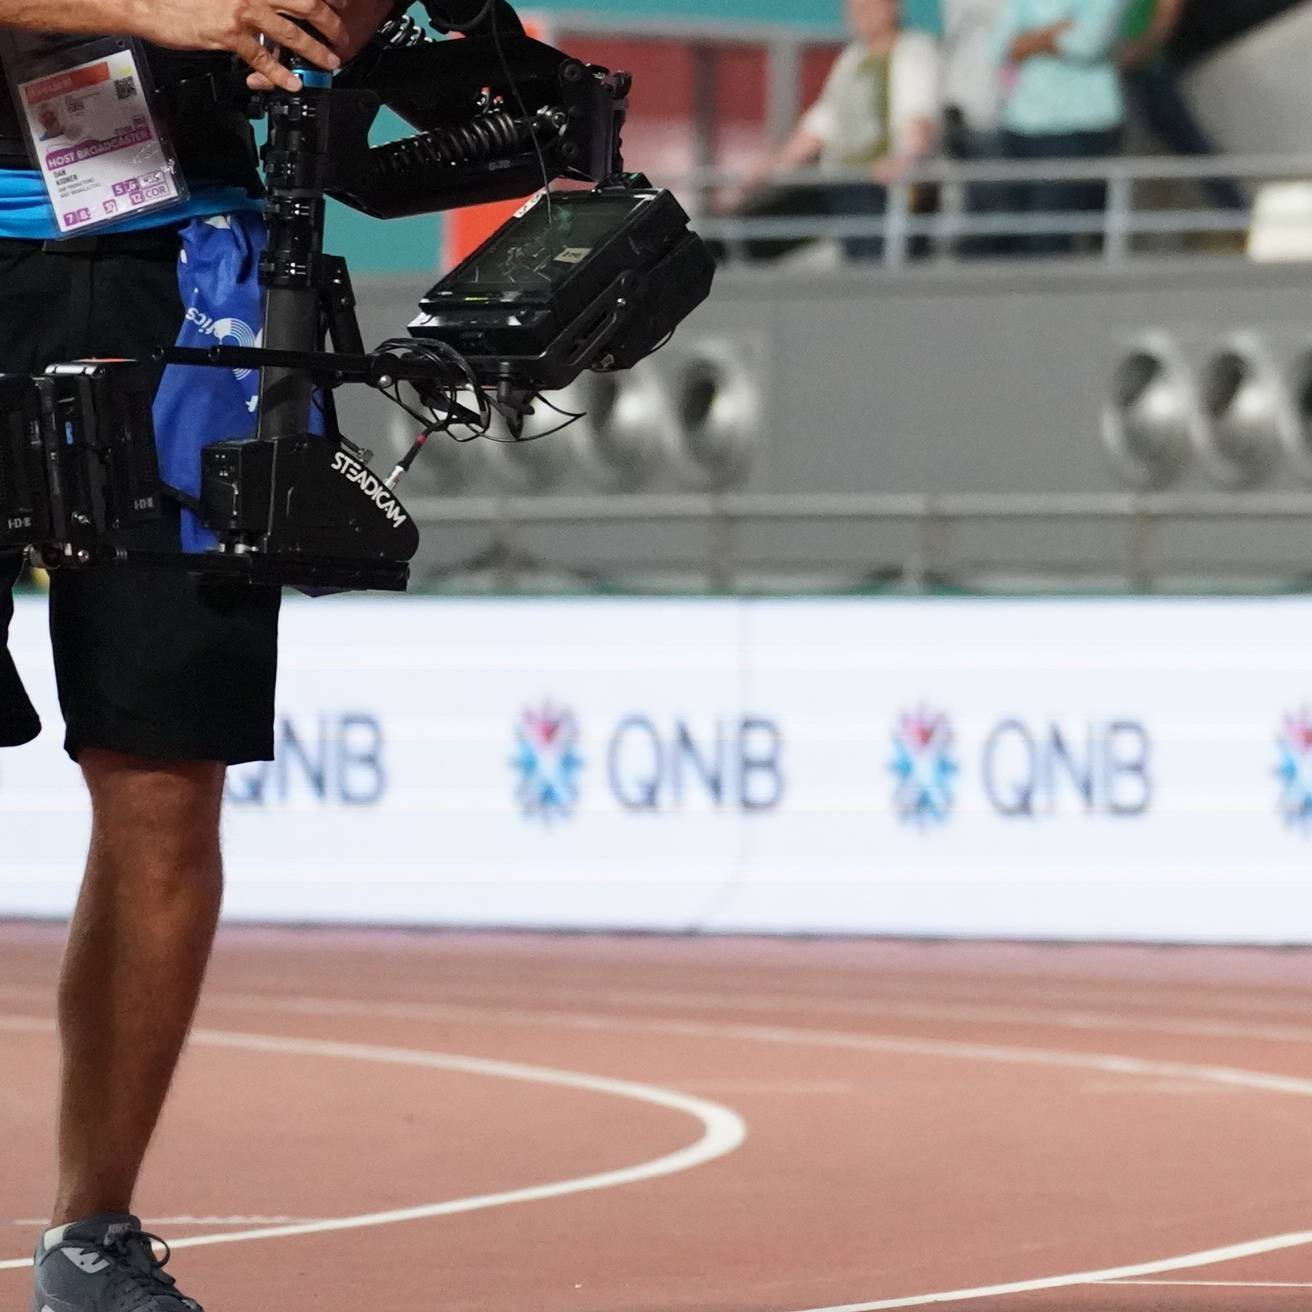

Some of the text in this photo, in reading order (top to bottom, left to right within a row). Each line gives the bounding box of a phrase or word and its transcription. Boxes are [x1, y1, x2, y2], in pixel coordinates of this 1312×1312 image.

[47, 152, 75, 168] HOST
[145, 186, 168, 198] COR
[331, 451, 407, 528] STEADICAM
[606, 712, 786, 812] QNB
[981, 717, 1153, 818] QNB
